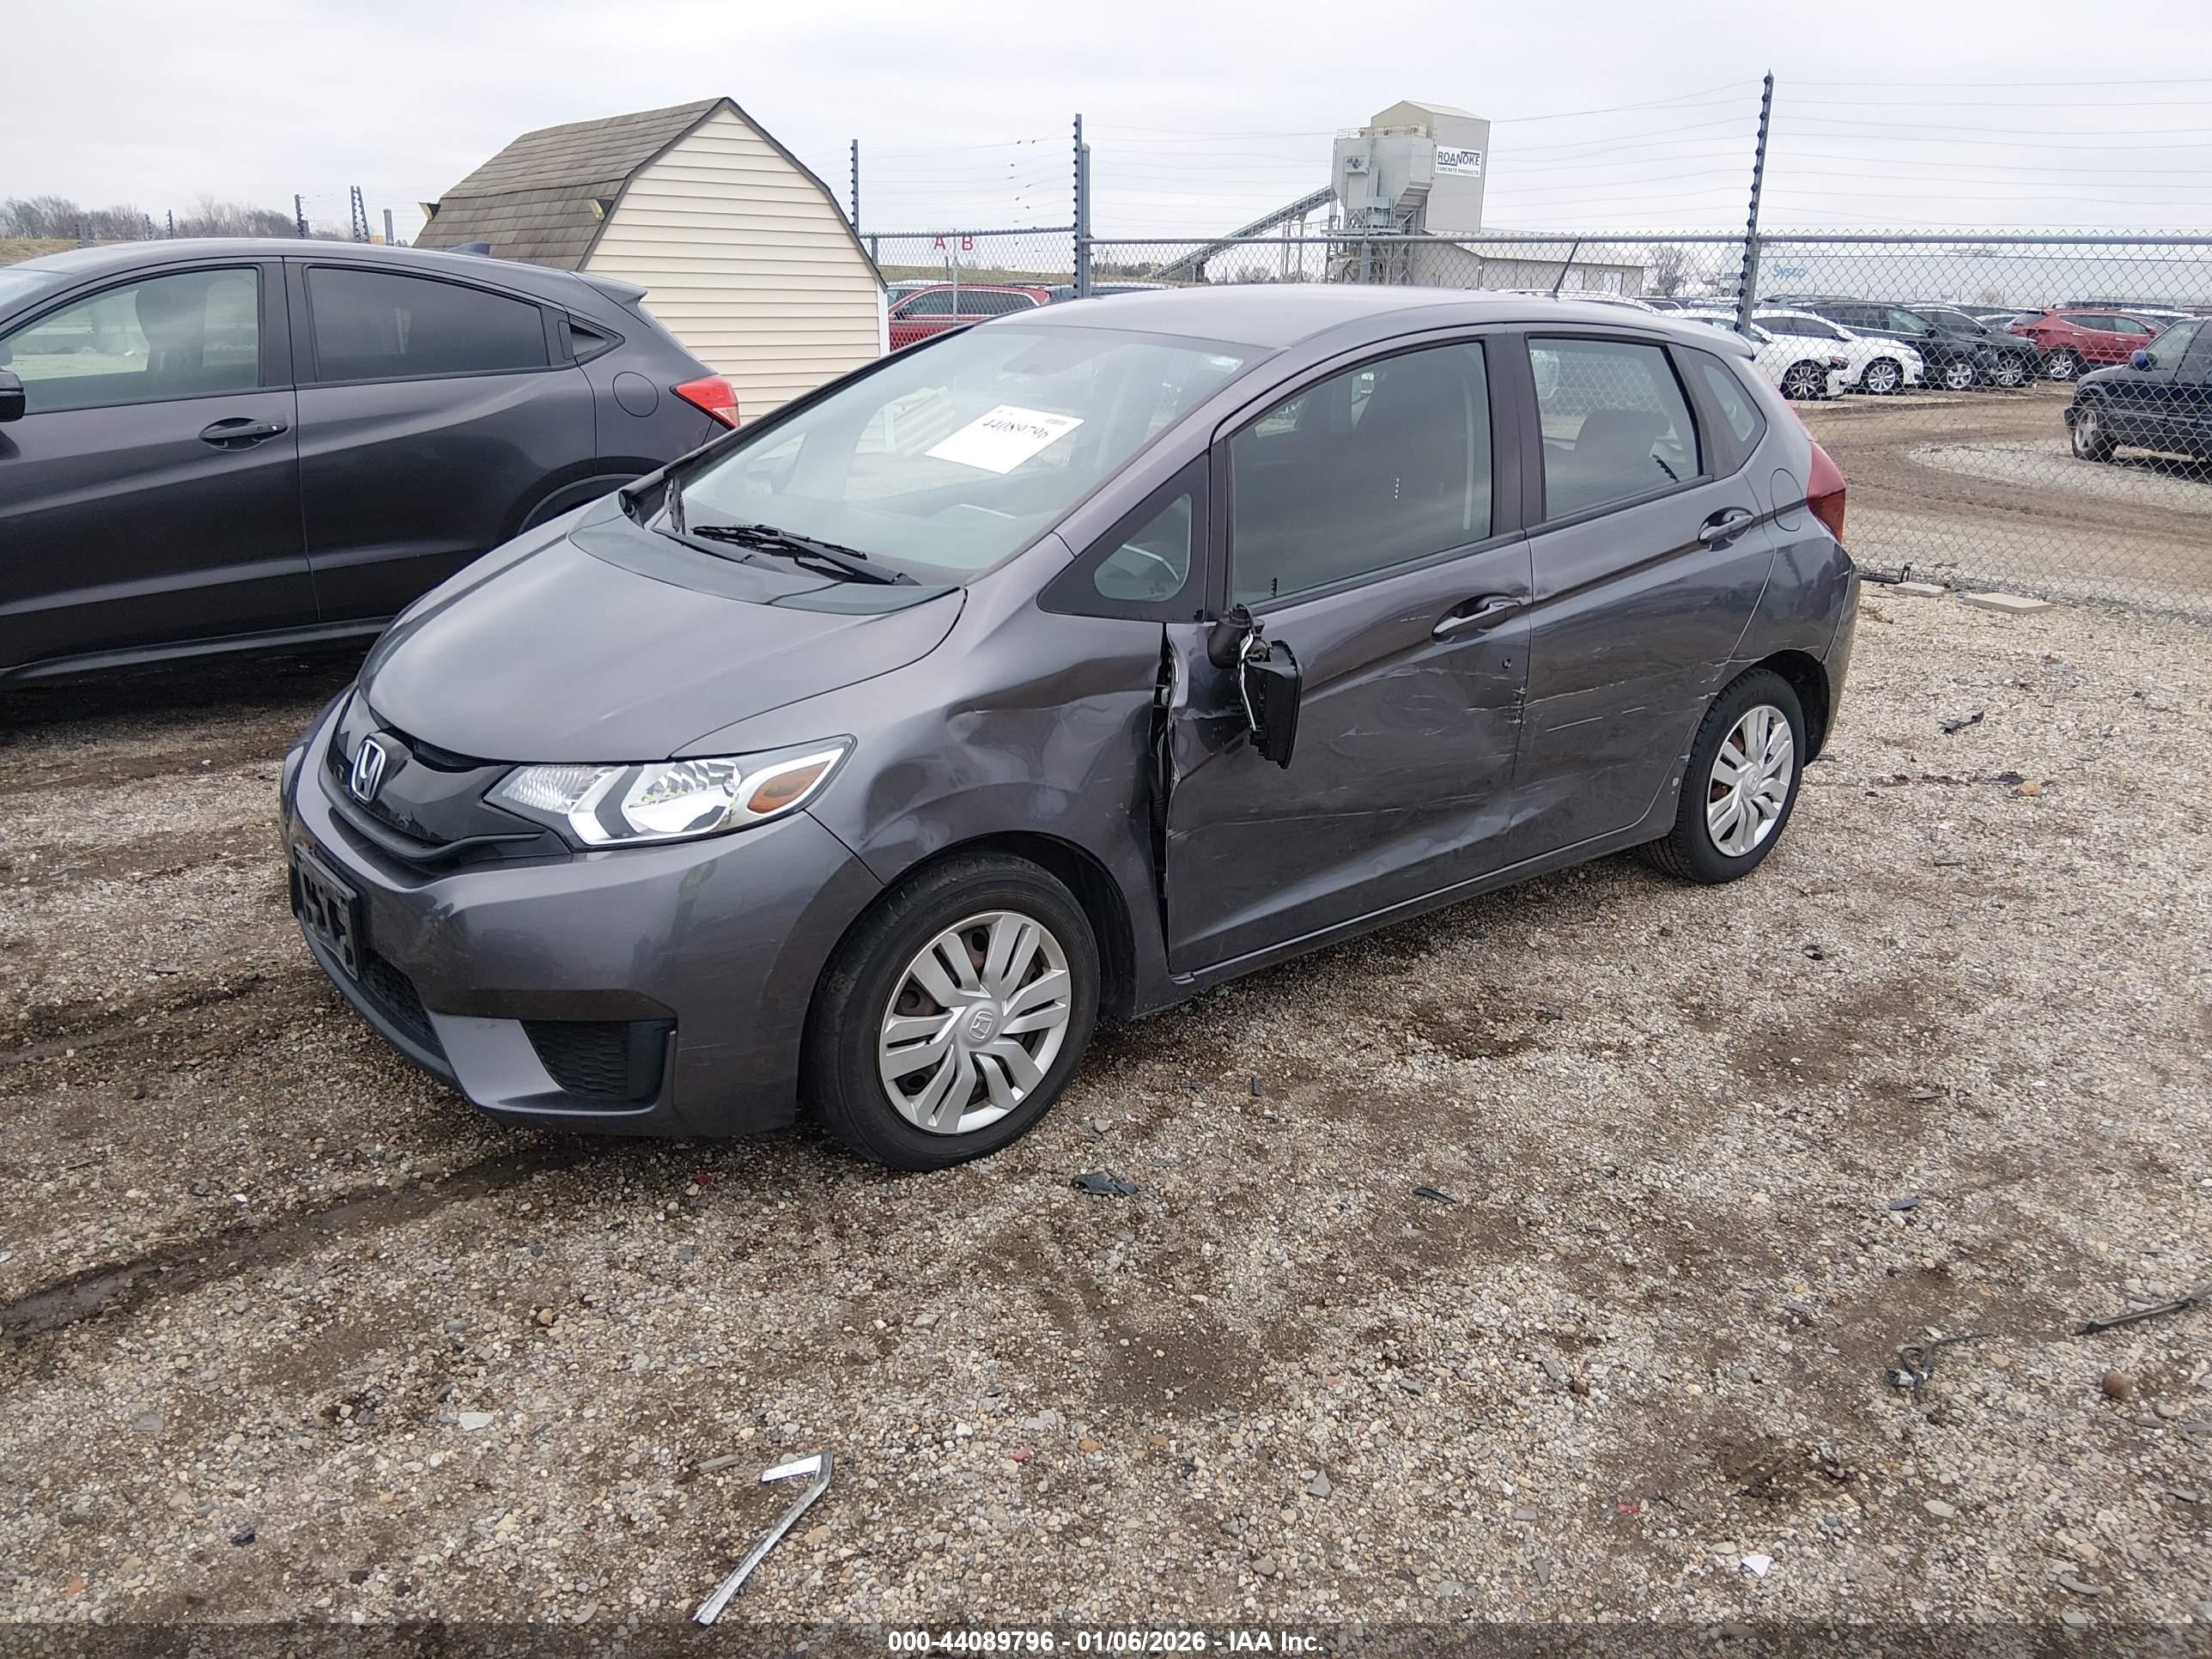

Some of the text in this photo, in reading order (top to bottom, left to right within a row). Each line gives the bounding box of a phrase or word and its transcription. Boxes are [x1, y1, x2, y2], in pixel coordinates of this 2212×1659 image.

[1437, 150, 1480, 166] ROANOKE
[933, 234, 974, 251] A B
